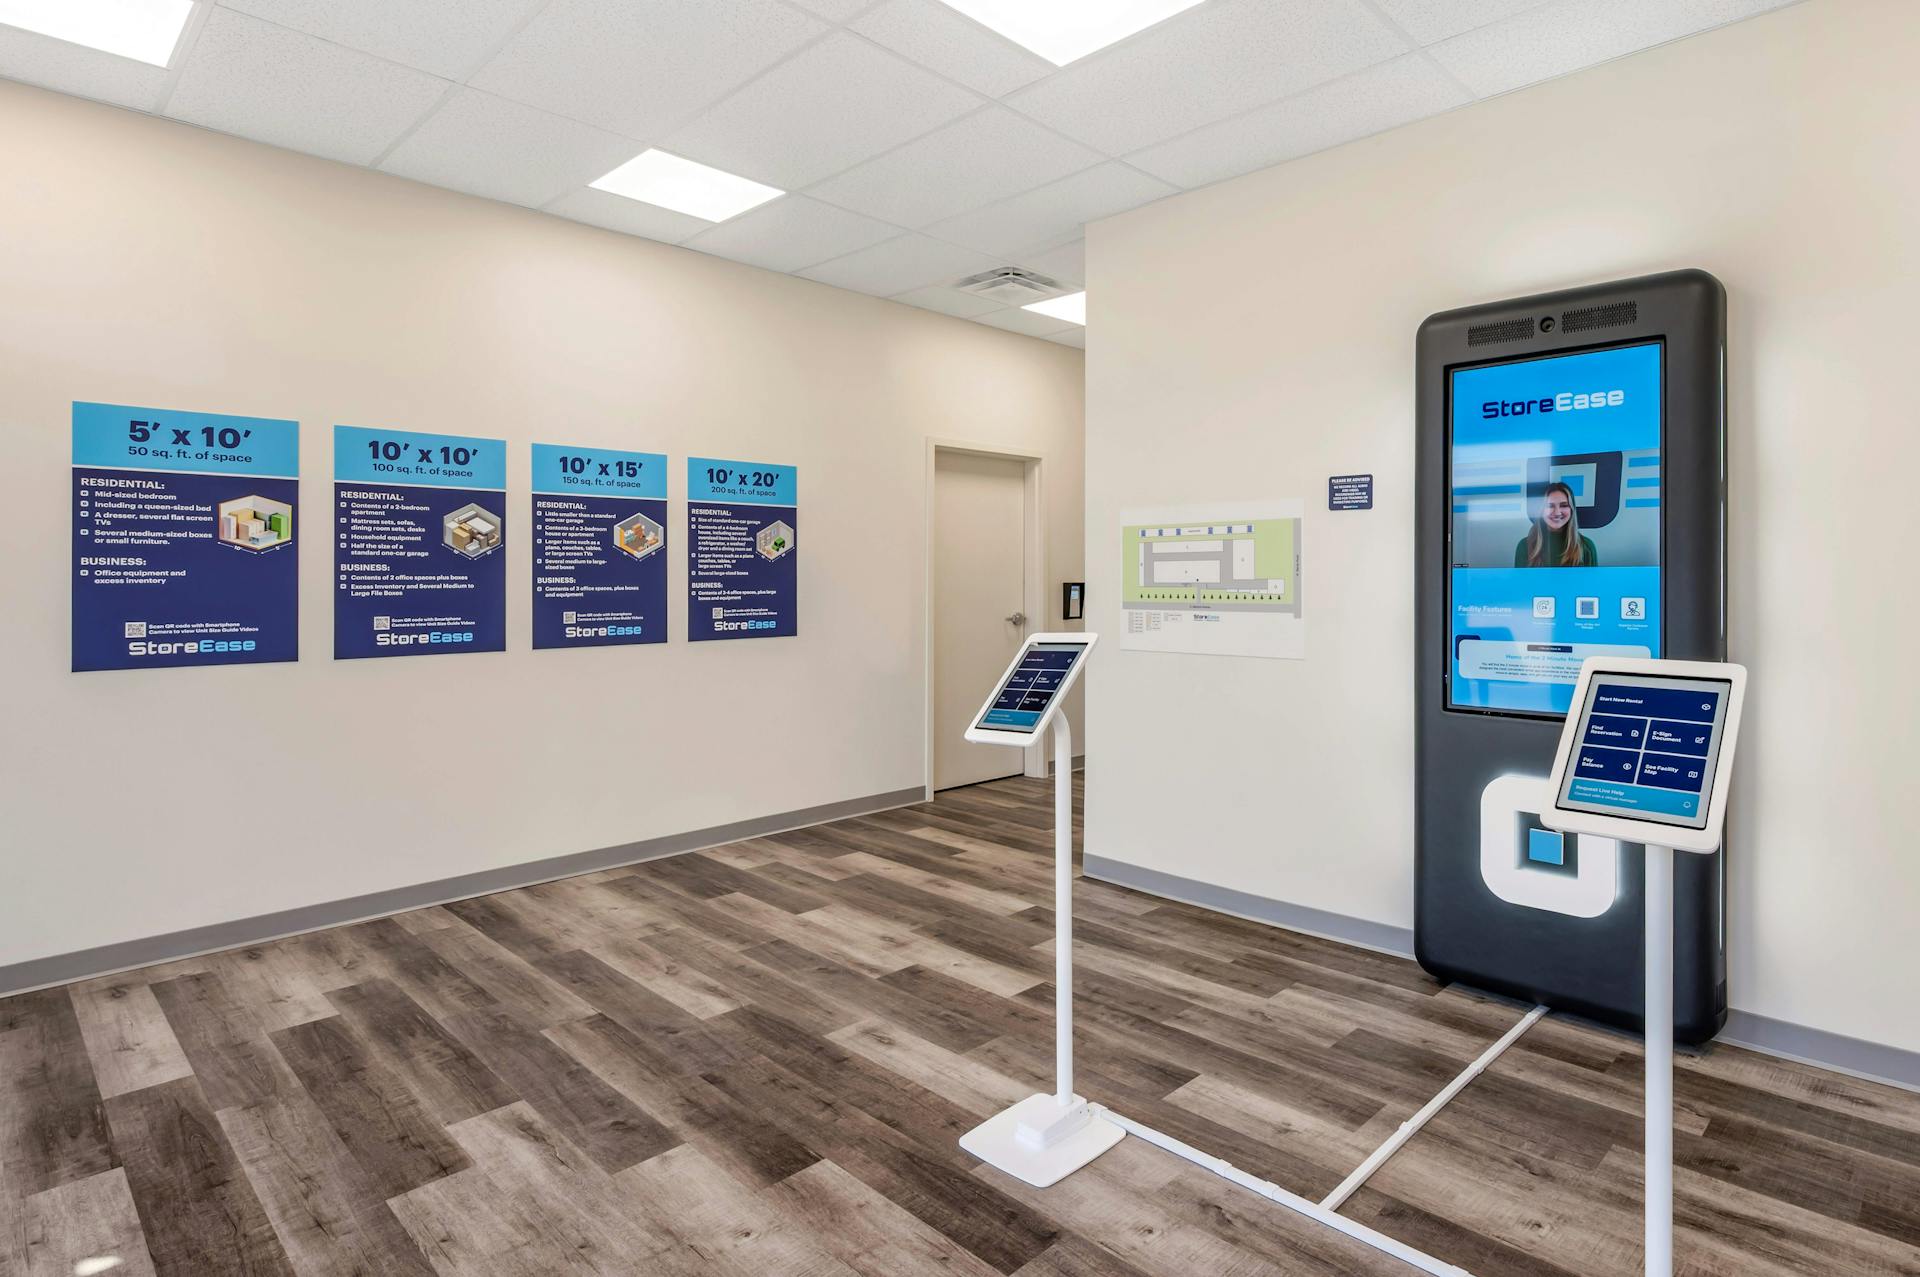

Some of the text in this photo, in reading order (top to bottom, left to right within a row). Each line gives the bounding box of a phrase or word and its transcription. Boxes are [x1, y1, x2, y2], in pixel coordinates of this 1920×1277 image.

[1482, 389, 1625, 419] StoreEase
[171, 429, 191, 446] x
[128, 446, 148, 456] 50
[195, 451, 209, 460] of
[212, 454, 252, 463] space
[417, 448, 433, 464] x
[372, 463, 394, 472] 100
[429, 467, 440, 475] of
[442, 469, 473, 477] space
[598, 463, 610, 476] x
[81, 478, 165, 489] RESIDENTIAL:
[562, 476, 579, 484] 150
[738, 474, 748, 486] x
[94, 491, 177, 500] Mid-sized bedroom
[340, 491, 404, 501] RESIDENTIAL:
[711, 486, 727, 494] 200
[747, 488, 755, 496] of
[94, 501, 136, 510] Including
[128, 530, 188, 538] medium-sized
[80, 557, 147, 566] BUSINESS:
[1482, 605, 1512, 613] Features
[565, 625, 642, 638] StoreEase
[376, 632, 473, 645] StoreEase
[128, 640, 256, 655] StoreEase
[1590, 729, 1623, 737] Reservation
[1651, 735, 1682, 743] Document
[1581, 761, 1604, 769] Balance
[1656, 765, 1679, 773] Facility
[1575, 784, 1598, 792] Request
[1611, 788, 1625, 796] Help
